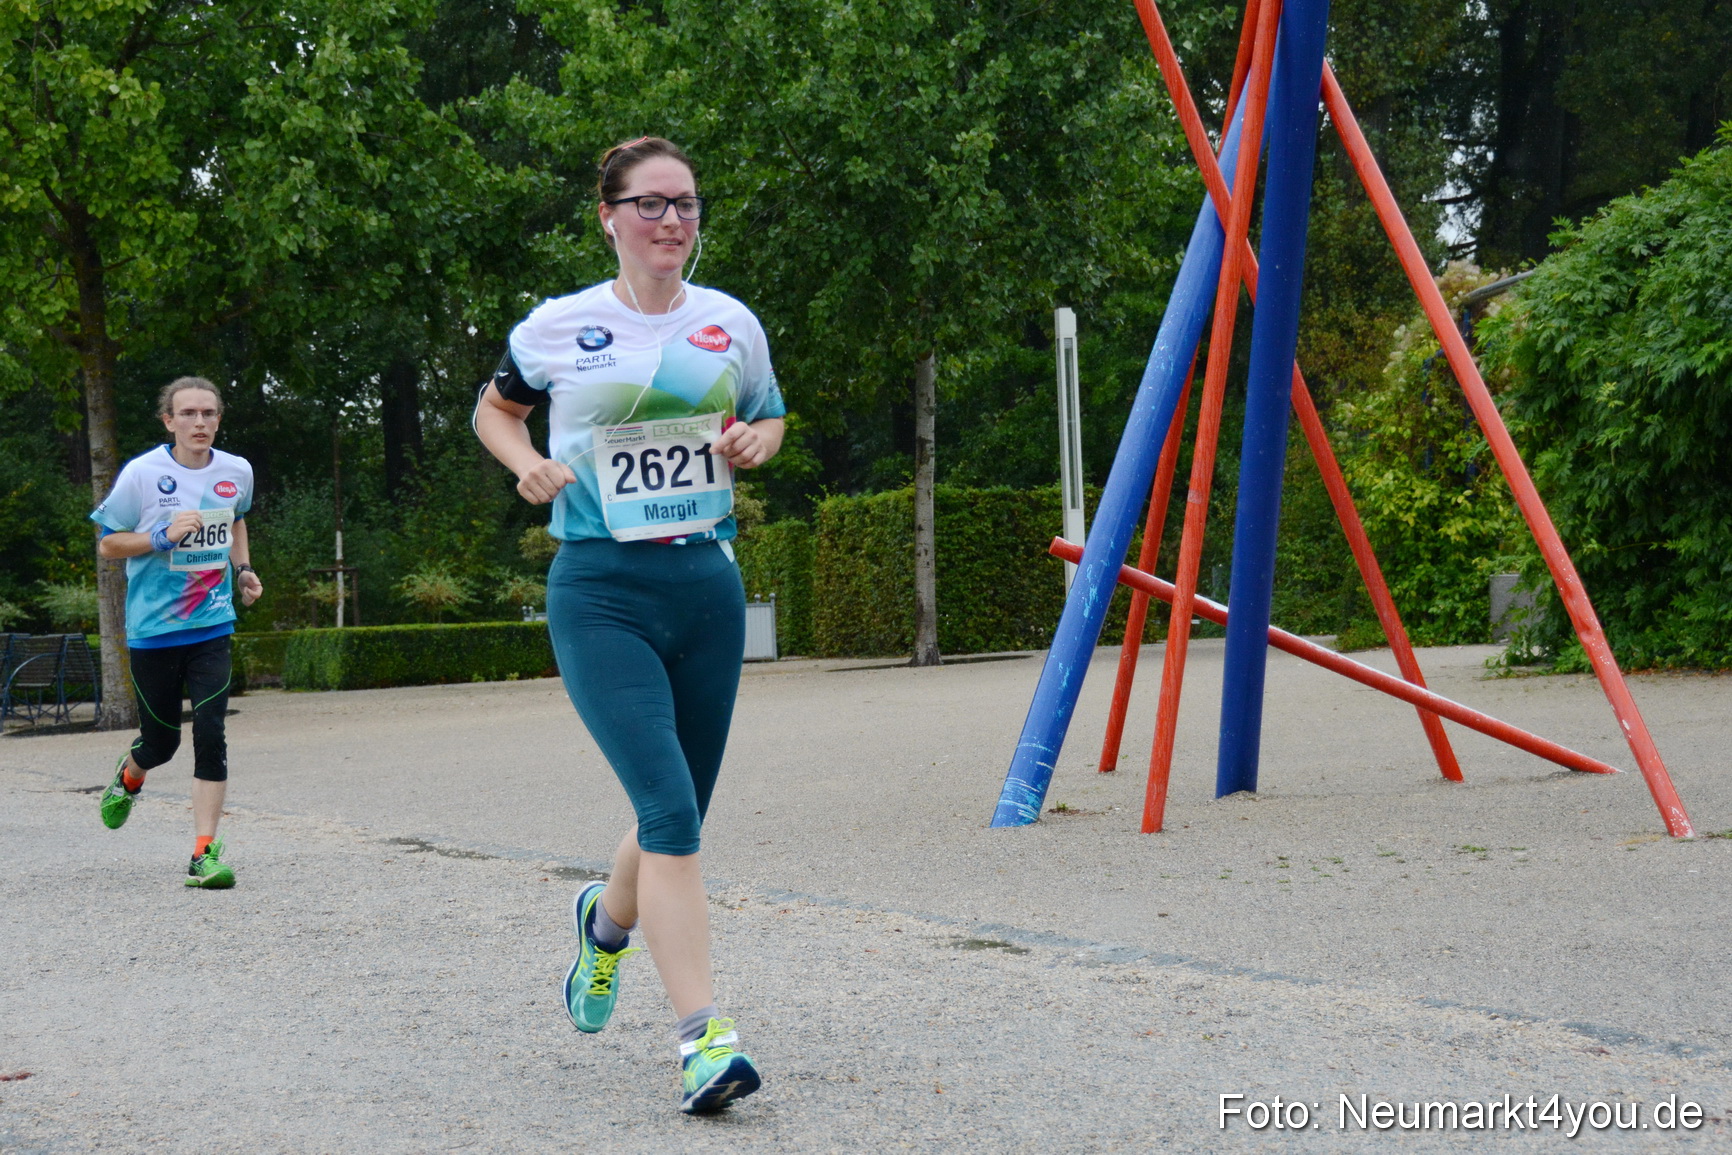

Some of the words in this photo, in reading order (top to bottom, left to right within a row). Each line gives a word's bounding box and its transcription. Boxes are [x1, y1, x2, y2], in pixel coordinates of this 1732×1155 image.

[694, 331, 727, 346] Hervis
[576, 354, 616, 365] PARTL
[577, 361, 616, 372] Neumarkt
[653, 420, 711, 437] BOCK
[612, 443, 715, 495] 2621
[643, 499, 698, 521] Margit
[179, 523, 227, 548] 2466
[187, 553, 222, 563] Christian
